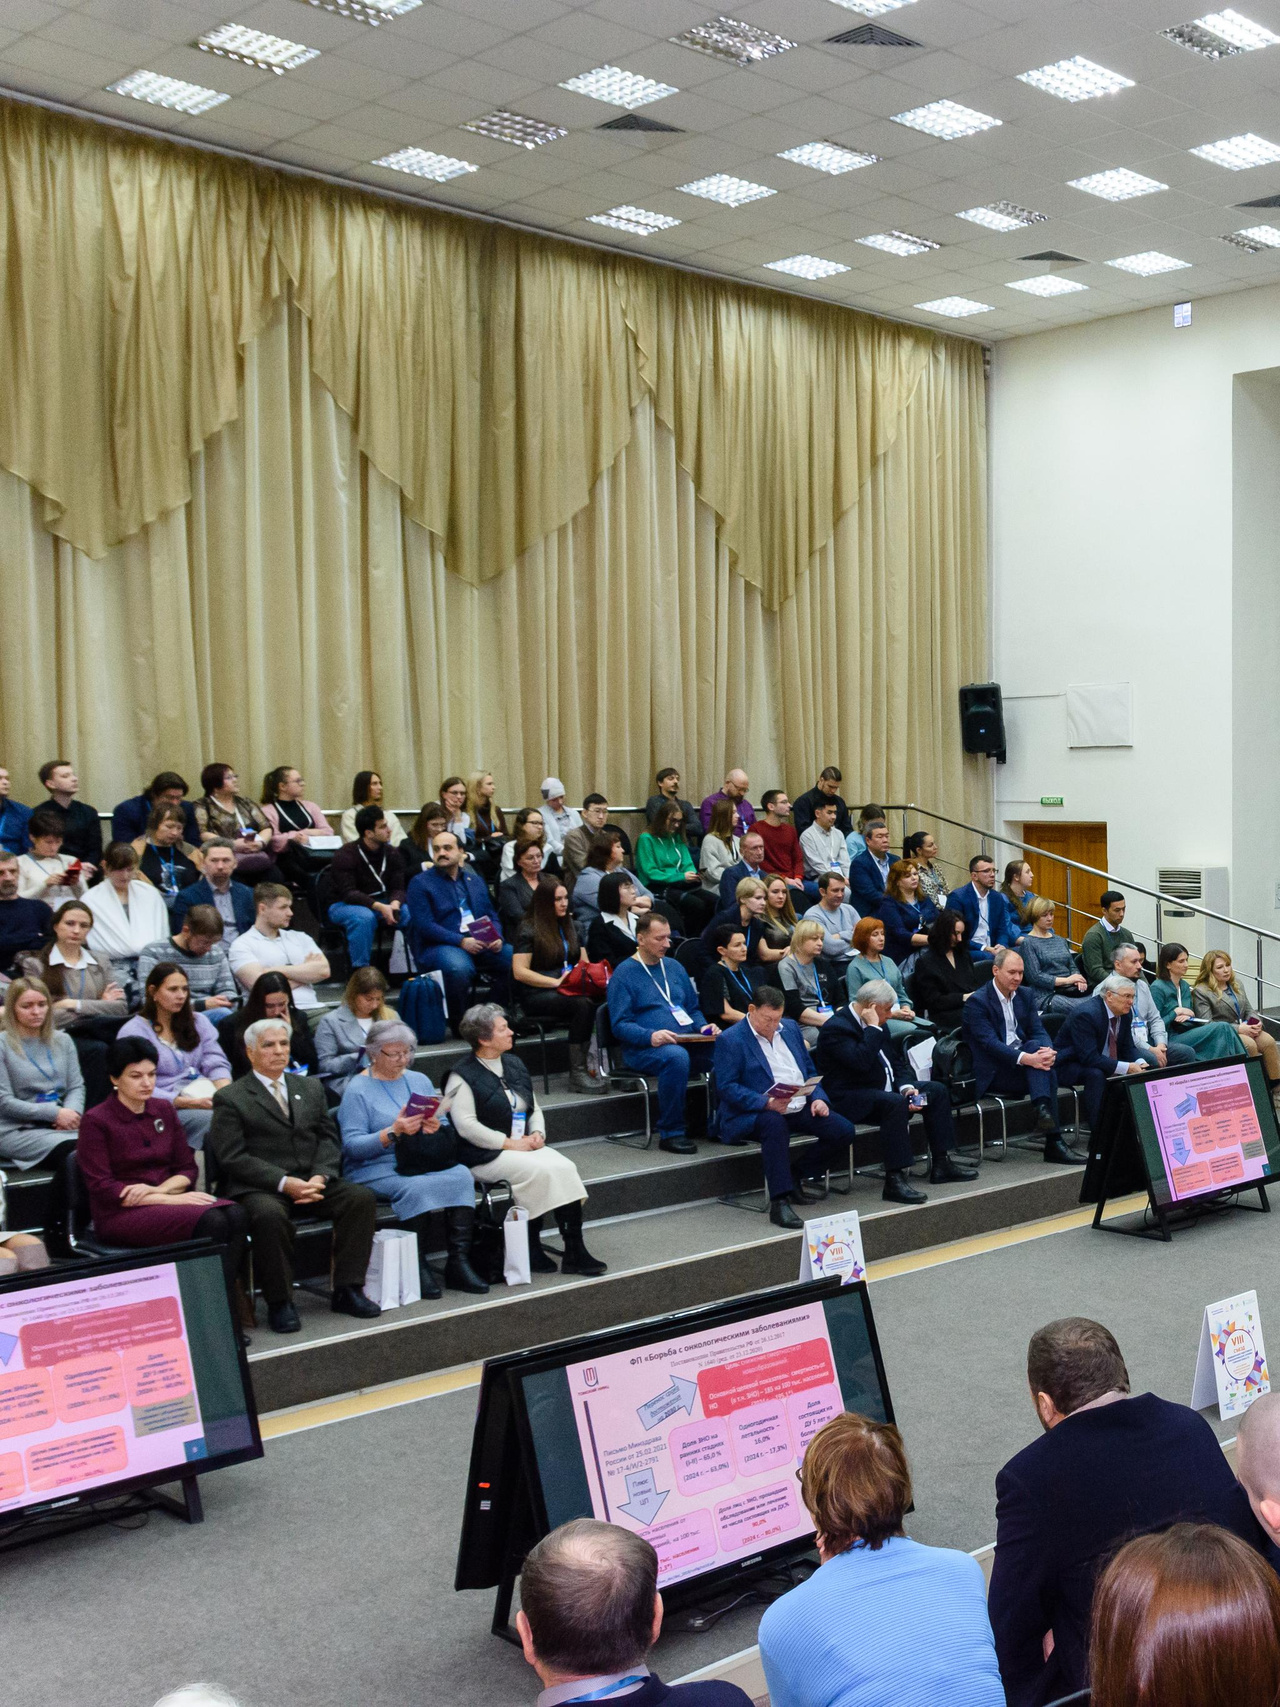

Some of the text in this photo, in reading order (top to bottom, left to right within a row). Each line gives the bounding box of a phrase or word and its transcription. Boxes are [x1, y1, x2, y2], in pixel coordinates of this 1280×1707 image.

[830, 1247, 843, 1255] VIII
[630, 1355, 643, 1366] ФП
[644, 1347, 677, 1362] «Борьба
[684, 1331, 750, 1350] онкологическими
[751, 1314, 810, 1335] заболеваниями»
[1231, 1334, 1245, 1346] VIII
[807, 1400, 821, 1409] Доля
[798, 1407, 826, 1420] состоящих
[739, 1415, 779, 1431] Одногодичная
[741, 1424, 775, 1439] летальность
[603, 1435, 662, 1457] Письмо Минздрава
[682, 1439, 697, 1449] Доля
[698, 1435, 710, 1443] ЗНО
[754, 1435, 771, 1445] 16,0%
[605, 1455, 627, 1467] России
[636, 1443, 667, 1458] 25.02.2021
[680, 1441, 724, 1459] ранних стадиях
[744, 1443, 787, 1463] (2024 17,3%)
[703, 1453, 716, 1461] 65,0
[616, 1456, 659, 1474] 17-4/И/2-2791
[683, 1462, 729, 1482] (2024 63,0%)
[632, 1478, 648, 1488] Плюс
[633, 1488, 652, 1497] новые
[640, 1498, 649, 1506] ЦП
[741, 1556, 762, 1568] SAMSUNG
